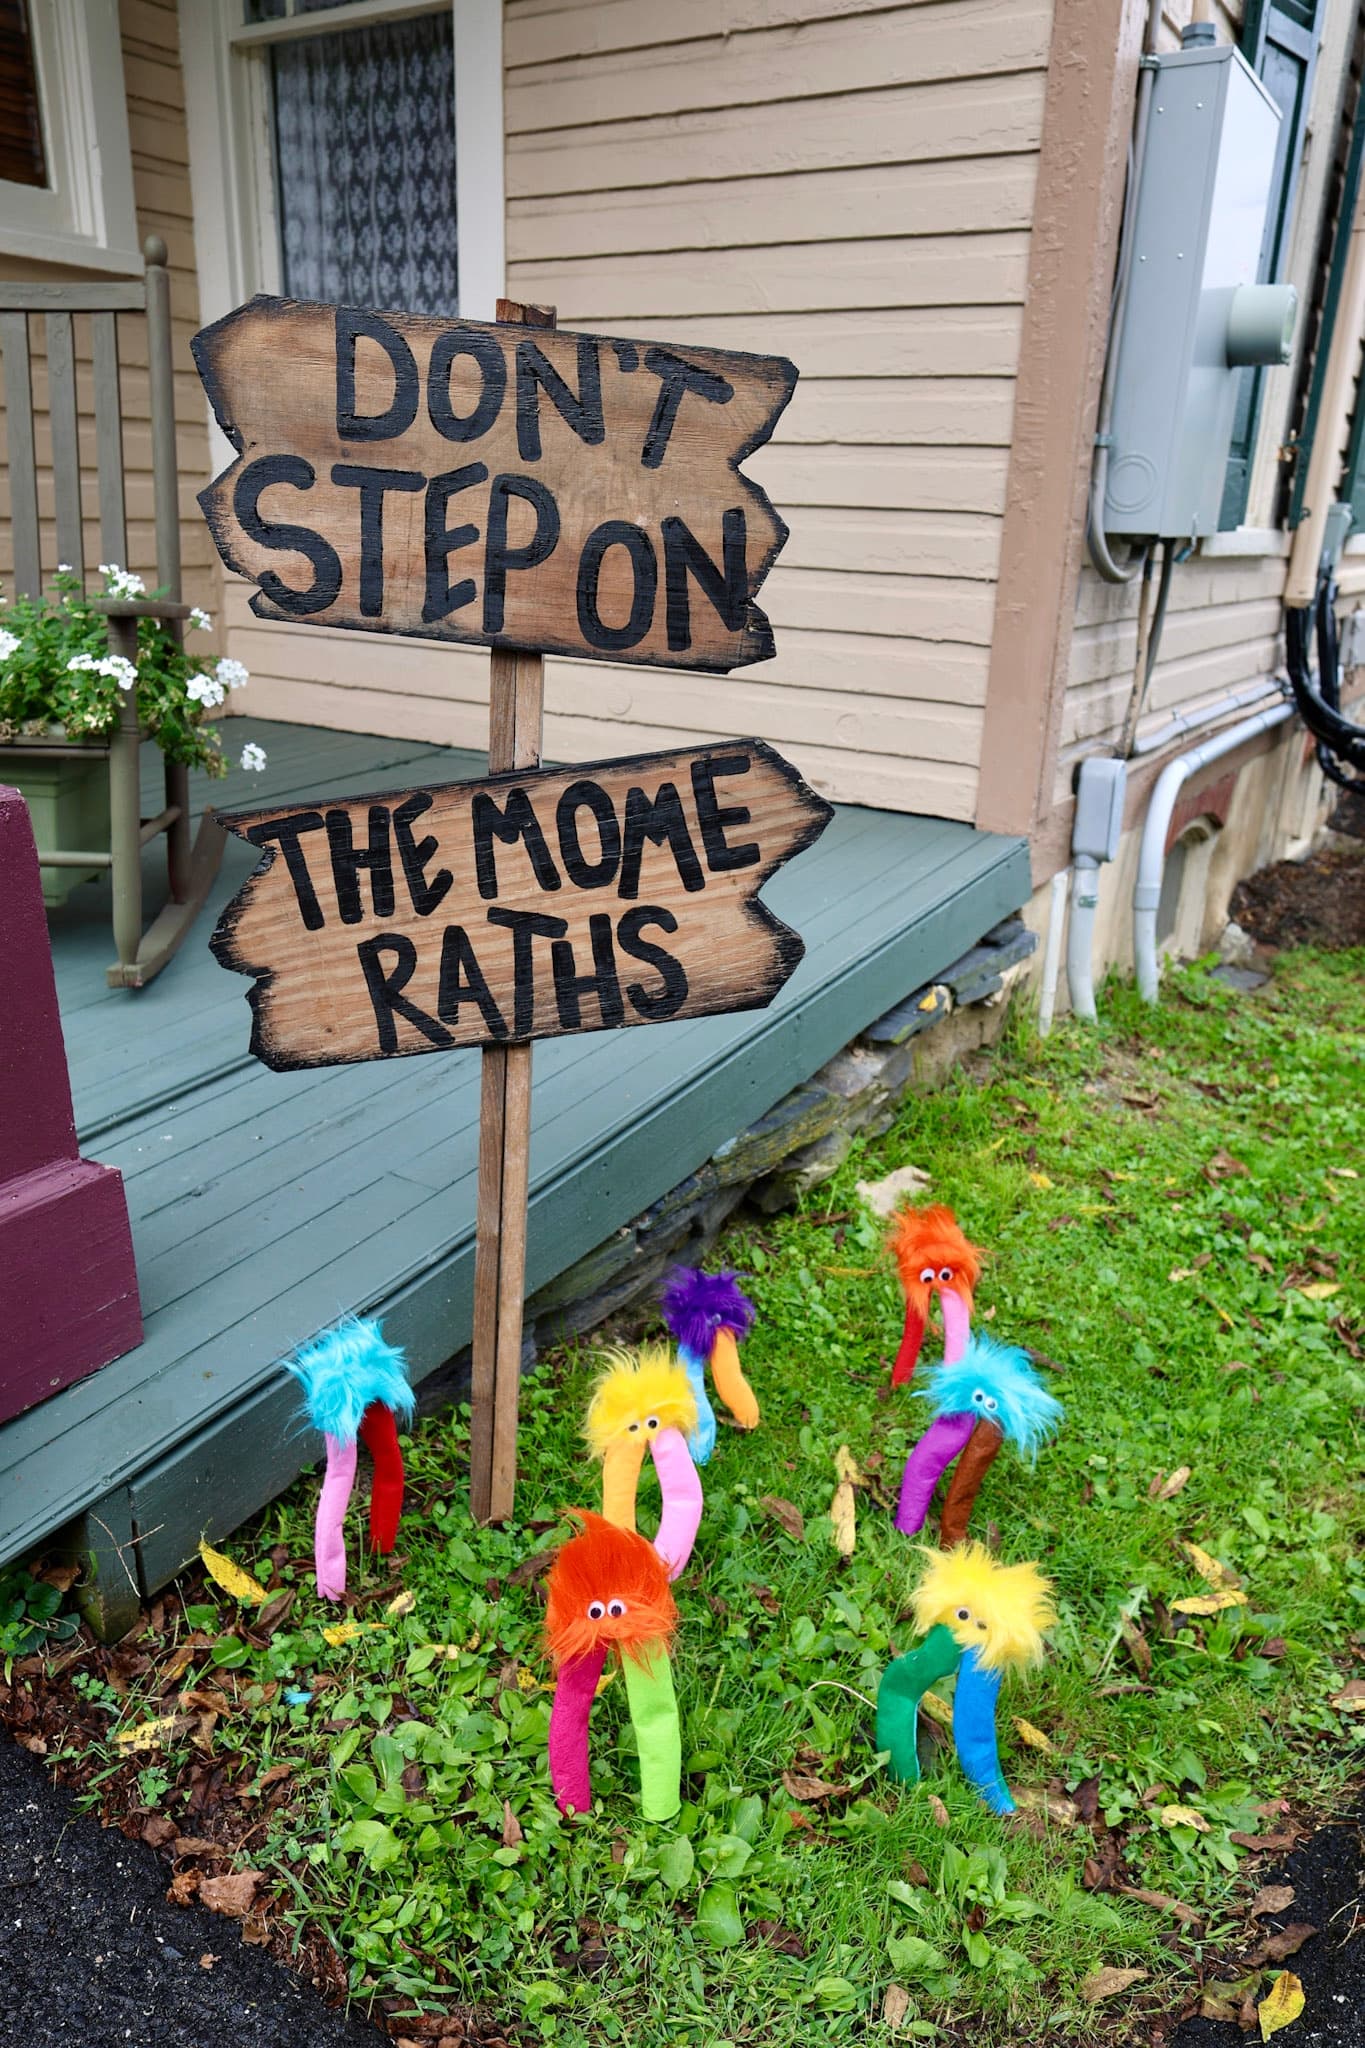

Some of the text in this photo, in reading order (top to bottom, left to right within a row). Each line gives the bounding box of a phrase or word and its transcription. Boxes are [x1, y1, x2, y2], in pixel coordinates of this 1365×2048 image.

[335, 306, 734, 468] DON'T
[233, 454, 749, 652] STEP ON
[247, 756, 761, 930] THE MOME
[357, 905, 689, 1053] RATHS
